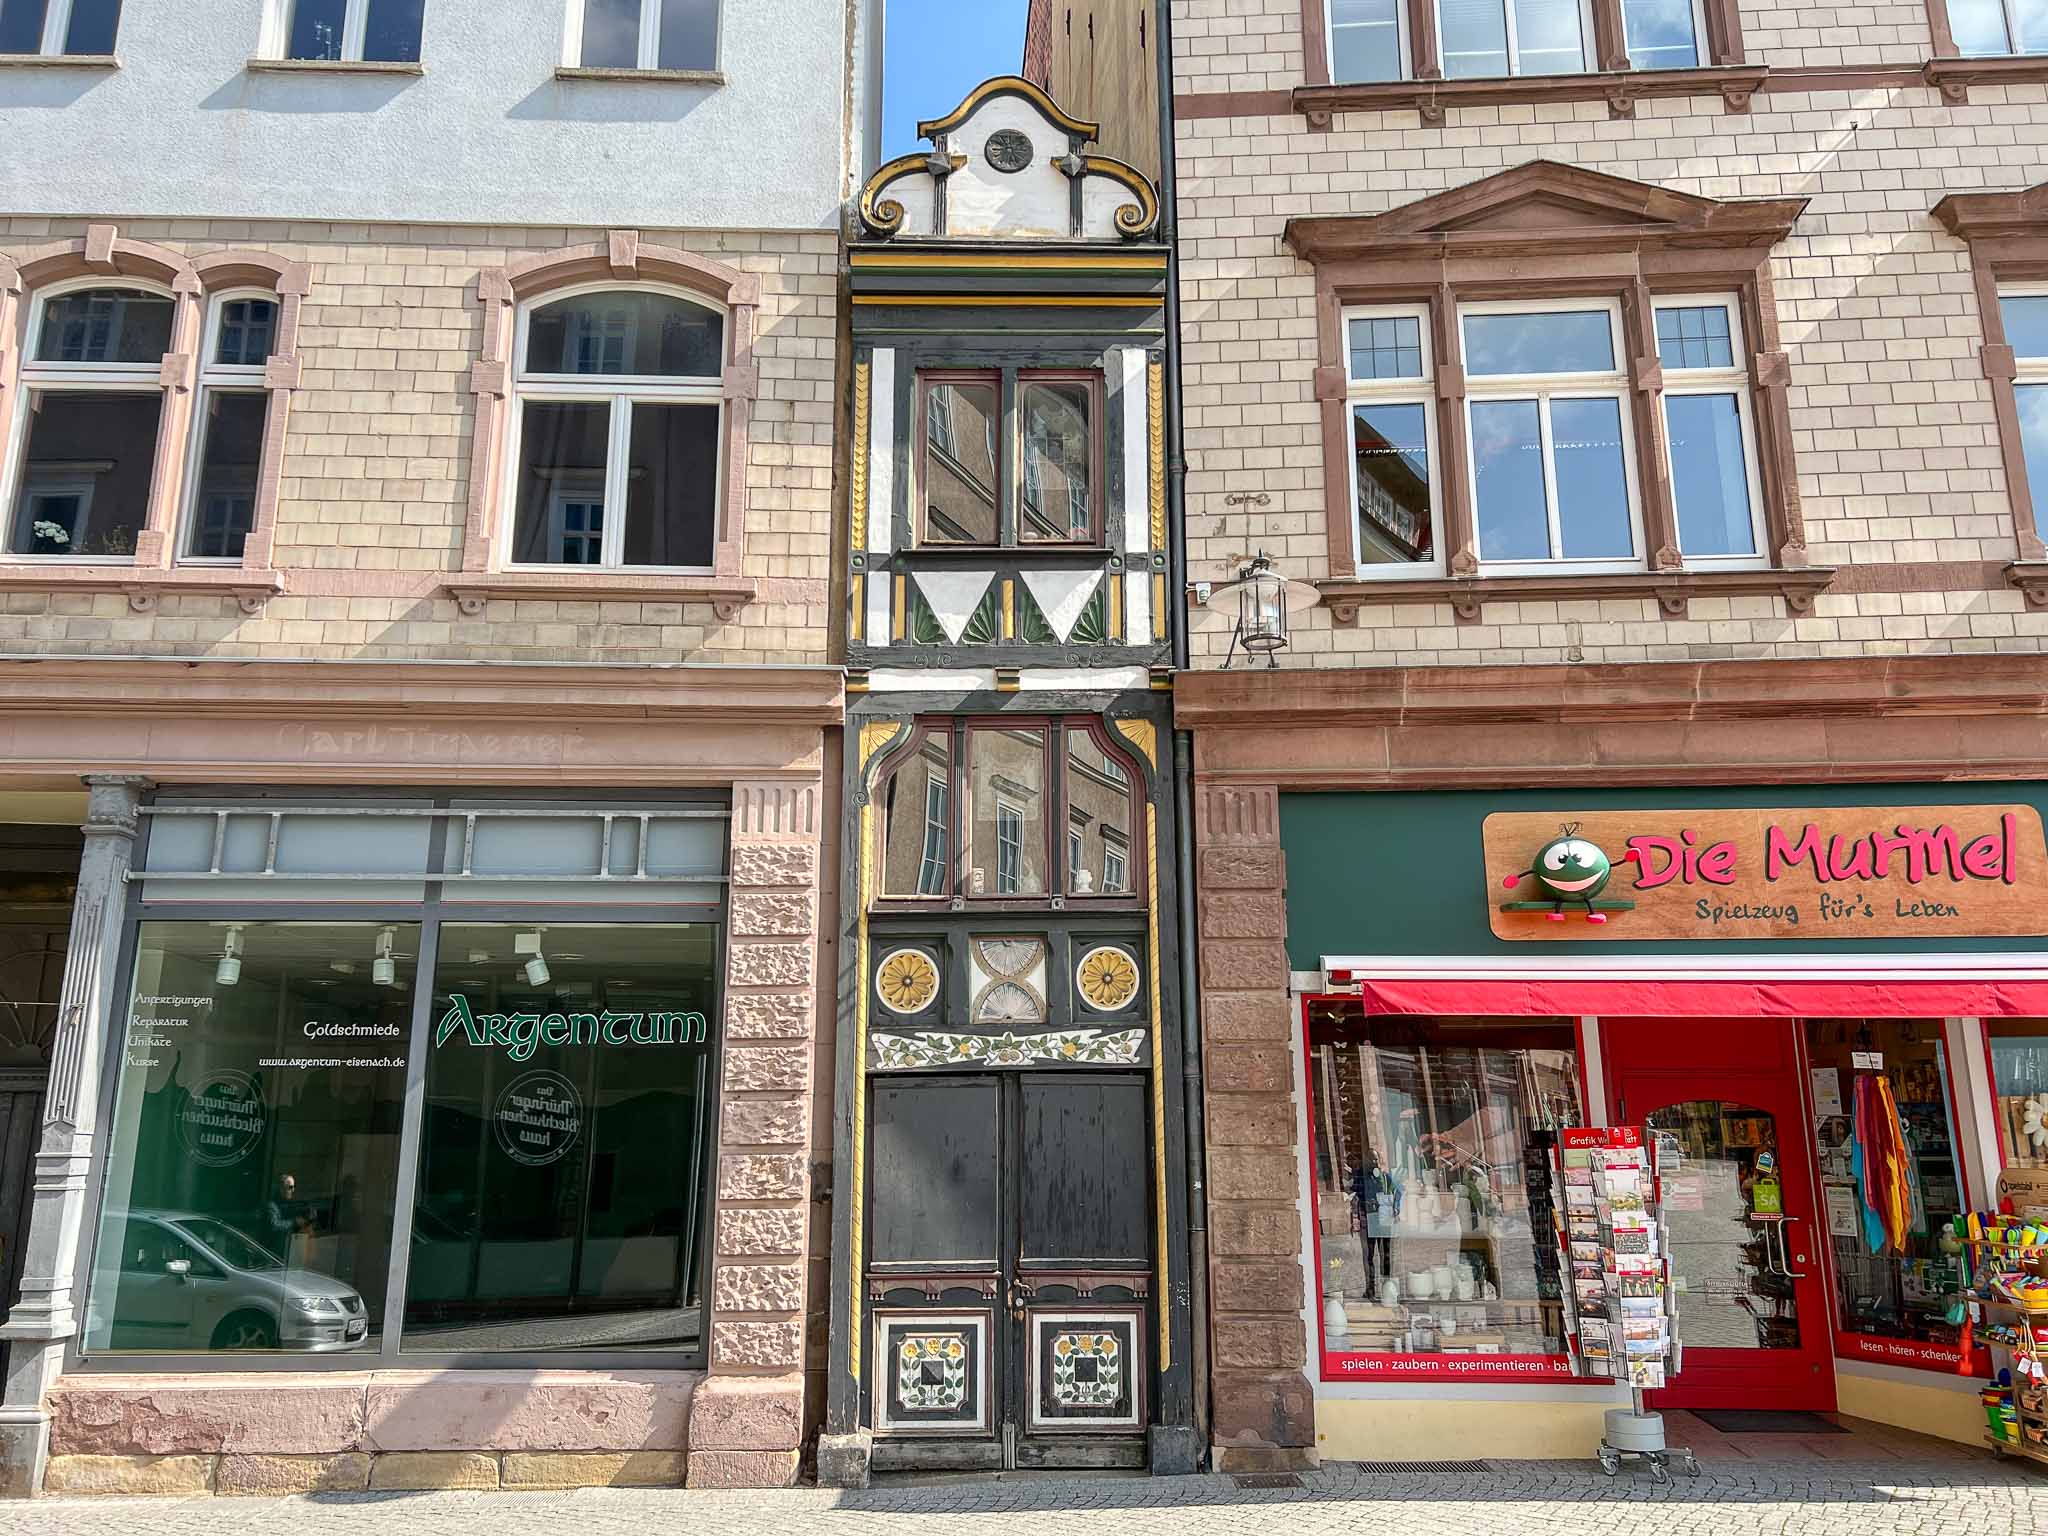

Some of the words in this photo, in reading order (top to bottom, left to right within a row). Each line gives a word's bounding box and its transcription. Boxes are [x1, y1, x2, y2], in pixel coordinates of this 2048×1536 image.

[1629, 828, 1737, 889] Die
[1767, 813, 2017, 885] Murmel
[1695, 898, 1799, 924] Spielzeug
[1819, 892, 1875, 921] für's
[1895, 898, 1960, 918] Leben
[132, 1015, 189, 1027] Reparatur
[436, 993, 707, 1062] Argentum
[303, 1022, 400, 1040] Goldschmiede
[128, 1035, 172, 1048] Unikate
[126, 1052, 160, 1067] Kurse
[259, 1057, 406, 1069] www.argentum-eisenach.de
[1570, 1136, 1596, 1145] Grafik
[1860, 1339, 1884, 1352] lesen
[1890, 1343, 1915, 1356] hören
[1342, 1358, 1383, 1372] spielen
[1392, 1359, 1439, 1371] zaubern
[1448, 1359, 1544, 1373] experimentieren
